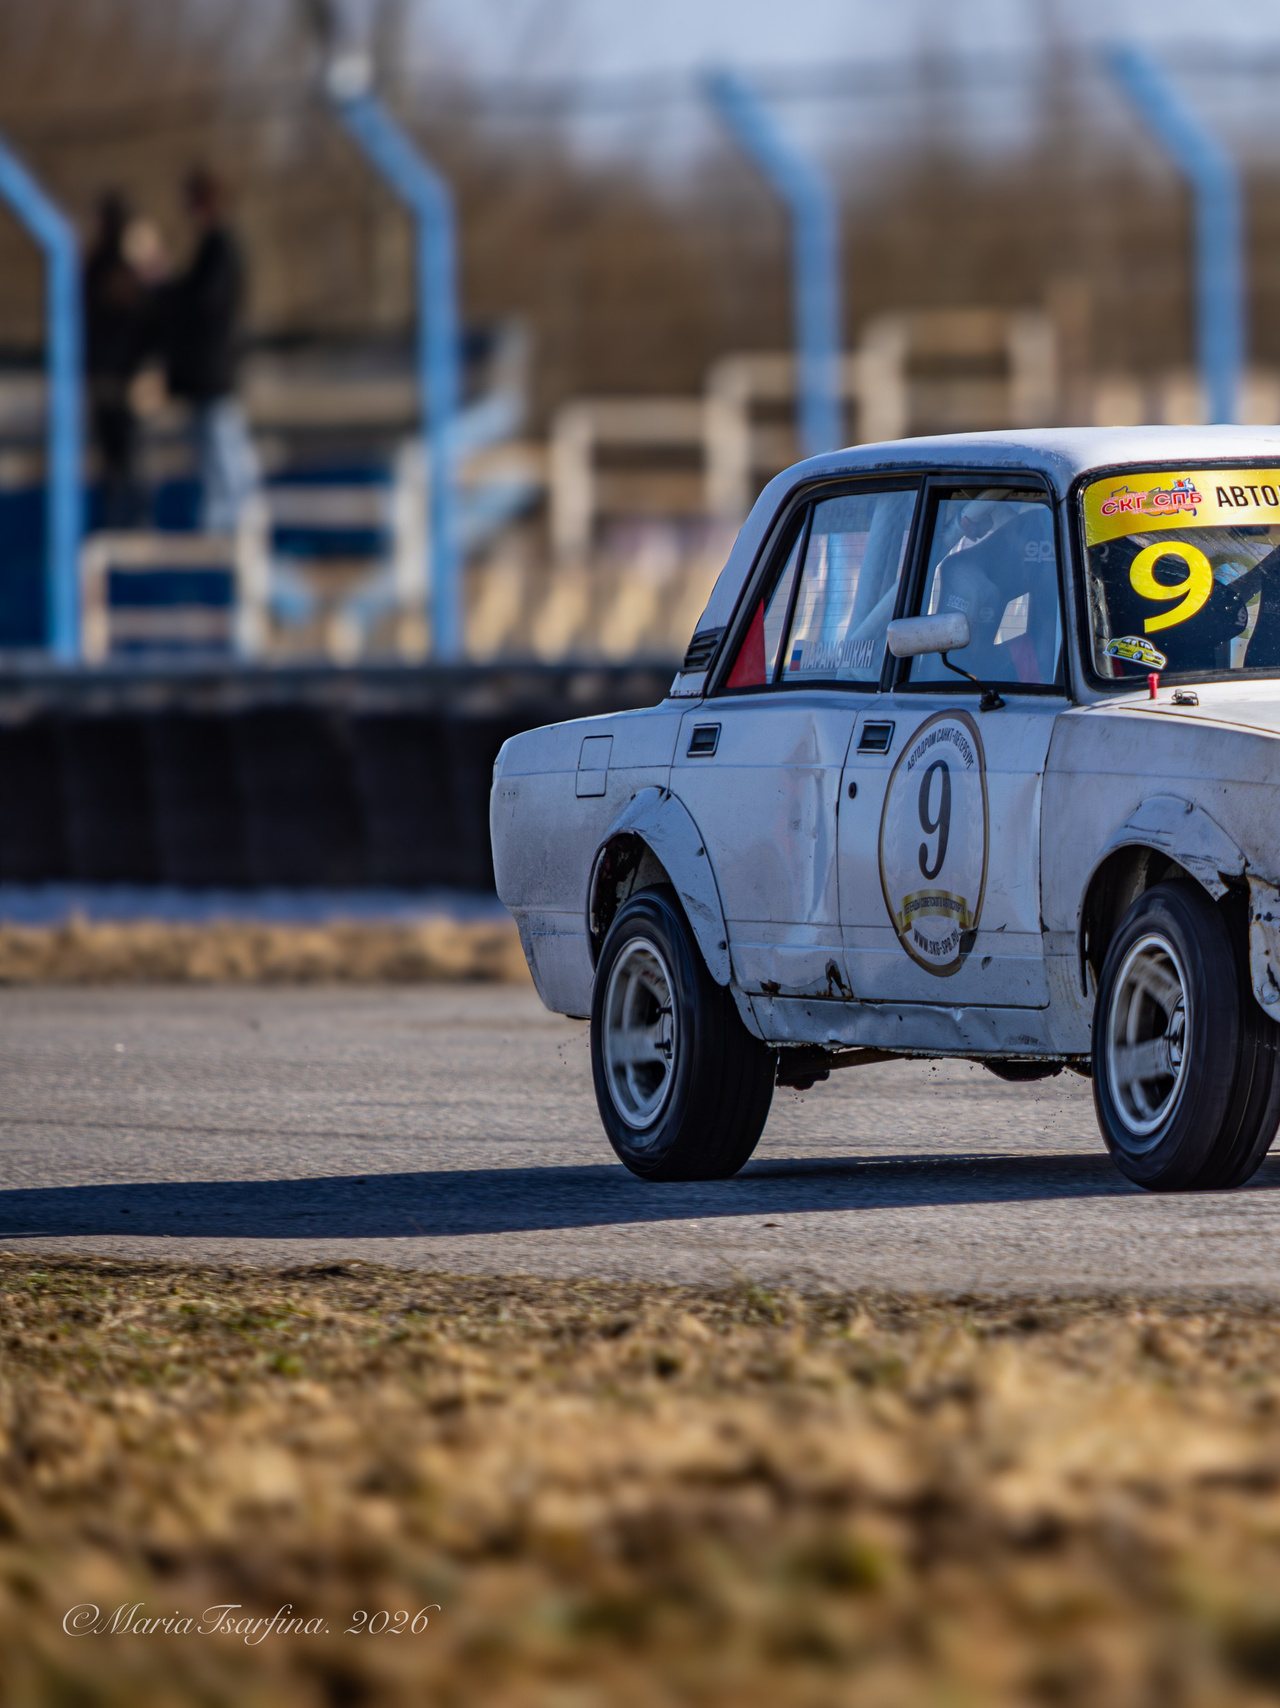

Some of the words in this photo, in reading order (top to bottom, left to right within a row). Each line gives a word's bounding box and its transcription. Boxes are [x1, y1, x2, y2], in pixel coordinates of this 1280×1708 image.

[1101, 495, 1147, 515] СКГ
[1154, 491, 1203, 507] СПБ
[1129, 541, 1214, 634] 9
[800, 640, 875, 669] ПАРАМОШКИН
[918, 759, 951, 880] 9
